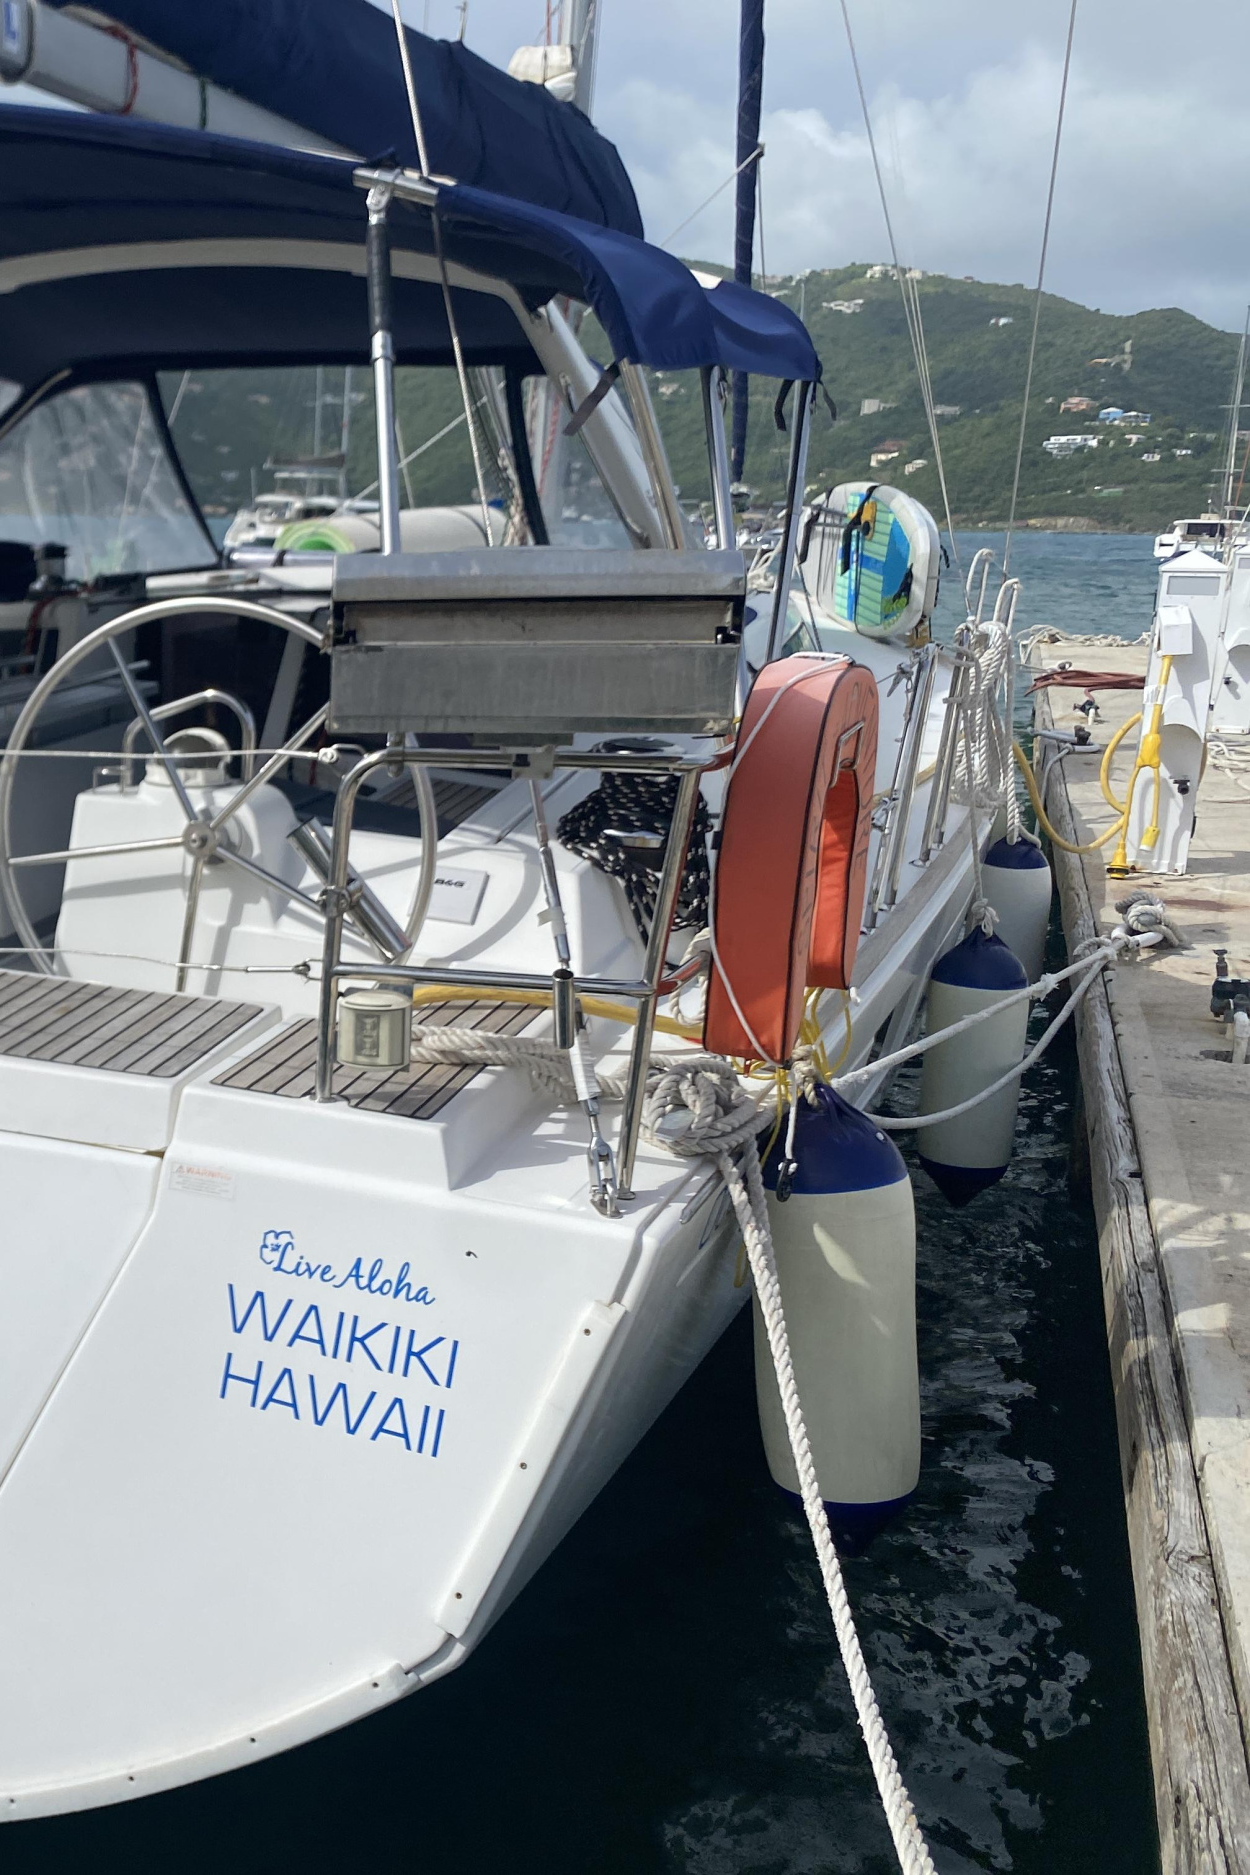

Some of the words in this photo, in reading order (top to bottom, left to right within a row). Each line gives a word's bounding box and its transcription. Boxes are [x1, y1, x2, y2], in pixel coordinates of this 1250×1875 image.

[272, 1241, 337, 1283] Live
[332, 1257, 436, 1306] Aloha
[227, 1283, 459, 1389] WAIKIKI
[219, 1352, 446, 1458] HAWAII
